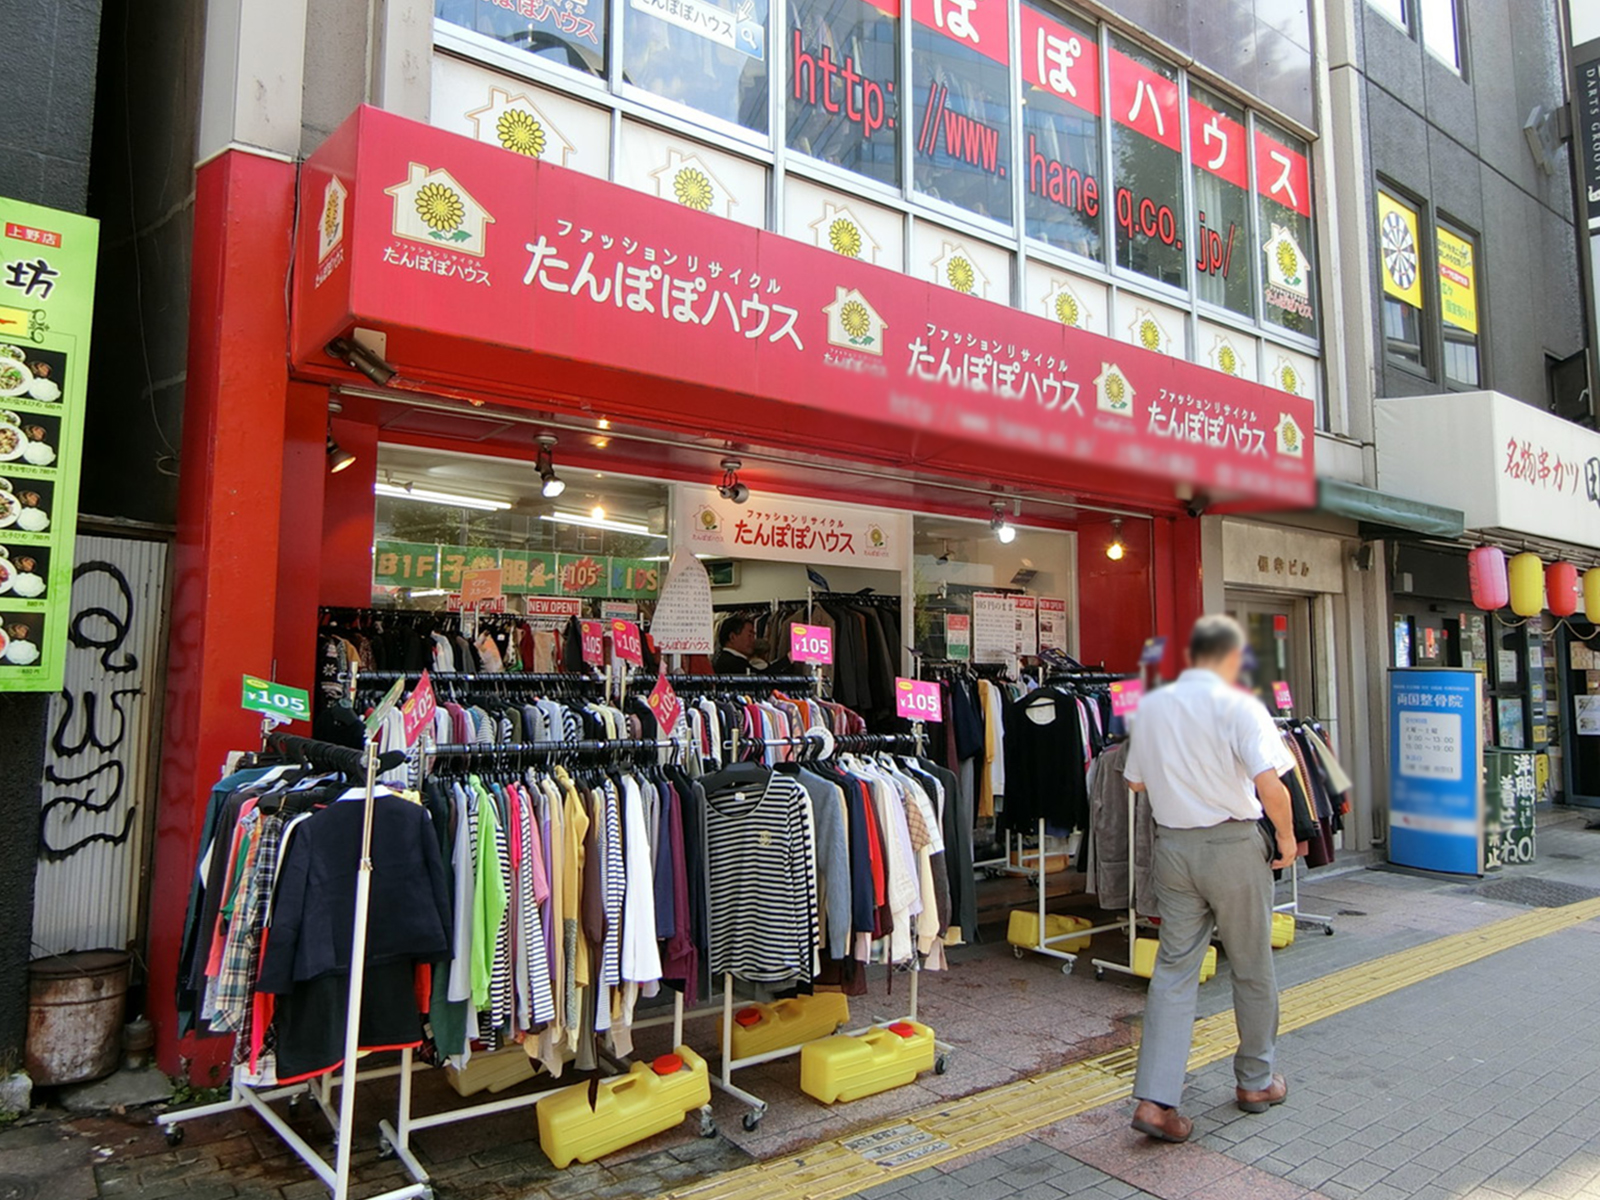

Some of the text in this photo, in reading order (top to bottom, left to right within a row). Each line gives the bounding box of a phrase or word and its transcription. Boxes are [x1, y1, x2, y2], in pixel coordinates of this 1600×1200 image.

[8, 224, 57, 246] 上野店
[383, 247, 491, 287] たんぽぽハウス
[557, 219, 782, 293] ファッションリサイクル
[5, 259, 59, 299] 坊
[523, 235, 804, 351] たんぽぽハウス
[907, 336, 1085, 417] たんぽぽハウス
[1147, 399, 1268, 458] たんぽぽハウス
[1504, 436, 1579, 497] 名物串カツ
[734, 519, 856, 555] たんぽぽハウス
[377, 553, 434, 578] B1F
[529, 601, 579, 614] NEW OPEN!!
[617, 633, 641, 656] ¥105
[795, 637, 829, 655] ¥105
[248, 690, 305, 712] ¥105
[407, 689, 433, 733] ¥105
[901, 693, 938, 712] ¥105
